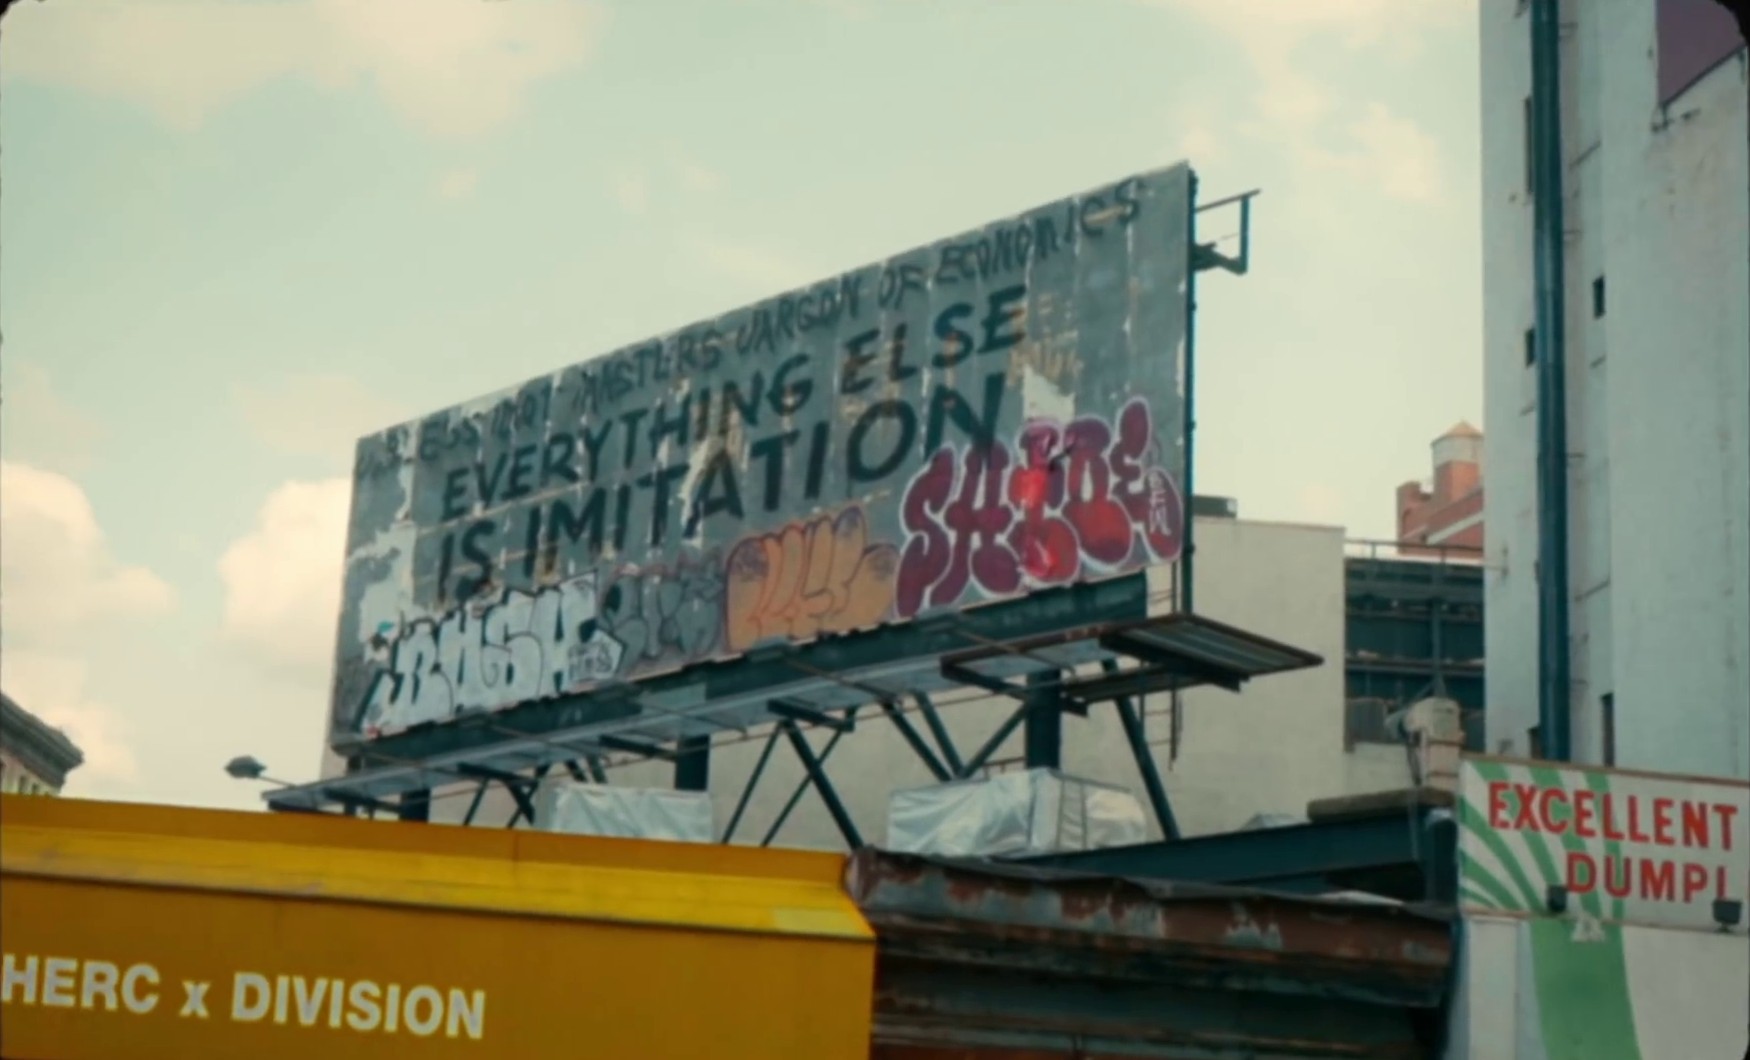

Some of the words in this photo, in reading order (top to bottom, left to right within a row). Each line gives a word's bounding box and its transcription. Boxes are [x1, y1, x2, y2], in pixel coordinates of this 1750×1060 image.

[737, 274, 862, 355] JARGON
[877, 263, 930, 312] OF
[936, 178, 1145, 285] ECONOMICS
[437, 521, 495, 602] IS
[523, 372, 1006, 579] IMITATION
[441, 355, 814, 522] EVERYTHING
[841, 284, 1026, 394] ELSE
[1488, 781, 1739, 851] EXCELLENT
[1, 953, 160, 1014] HERC
[231, 971, 486, 1039] DIVISION
